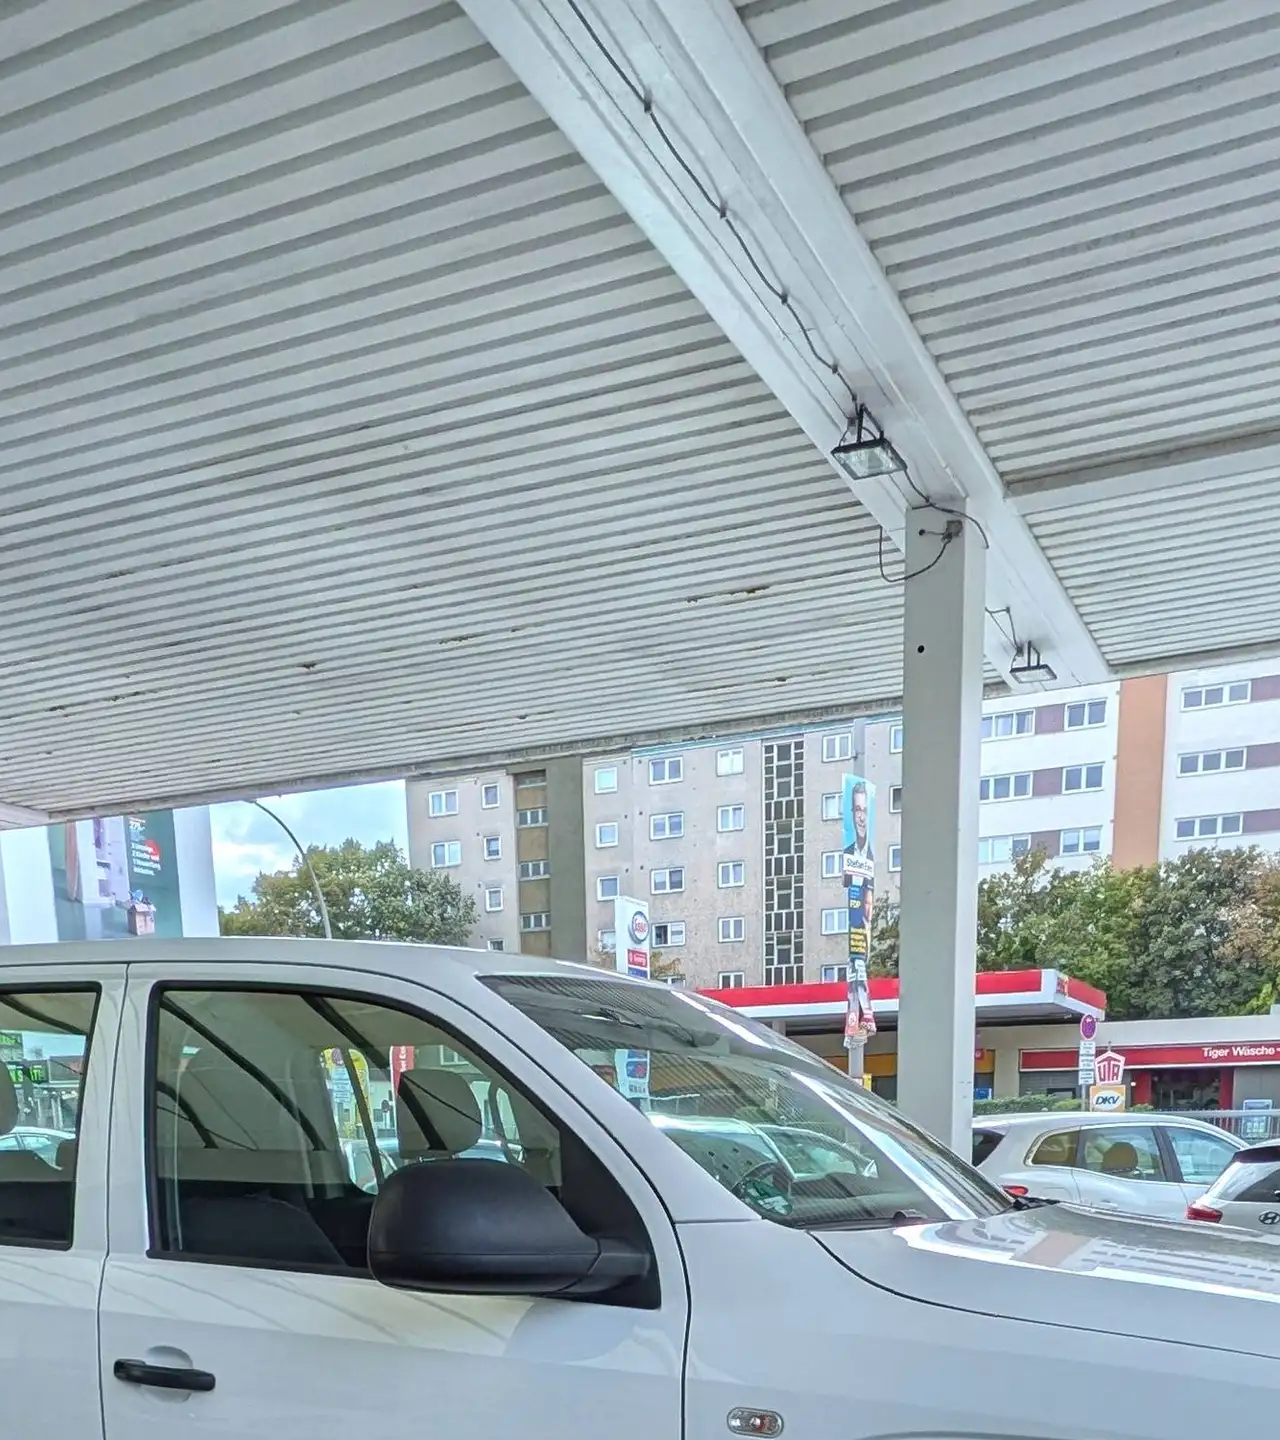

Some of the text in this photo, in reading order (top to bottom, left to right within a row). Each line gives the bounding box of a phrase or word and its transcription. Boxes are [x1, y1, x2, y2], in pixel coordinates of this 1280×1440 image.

[1201, 1046, 1230, 1060] Tiger
[1096, 1057, 1121, 1083] UTA
[1095, 1095, 1120, 1105] DKV
